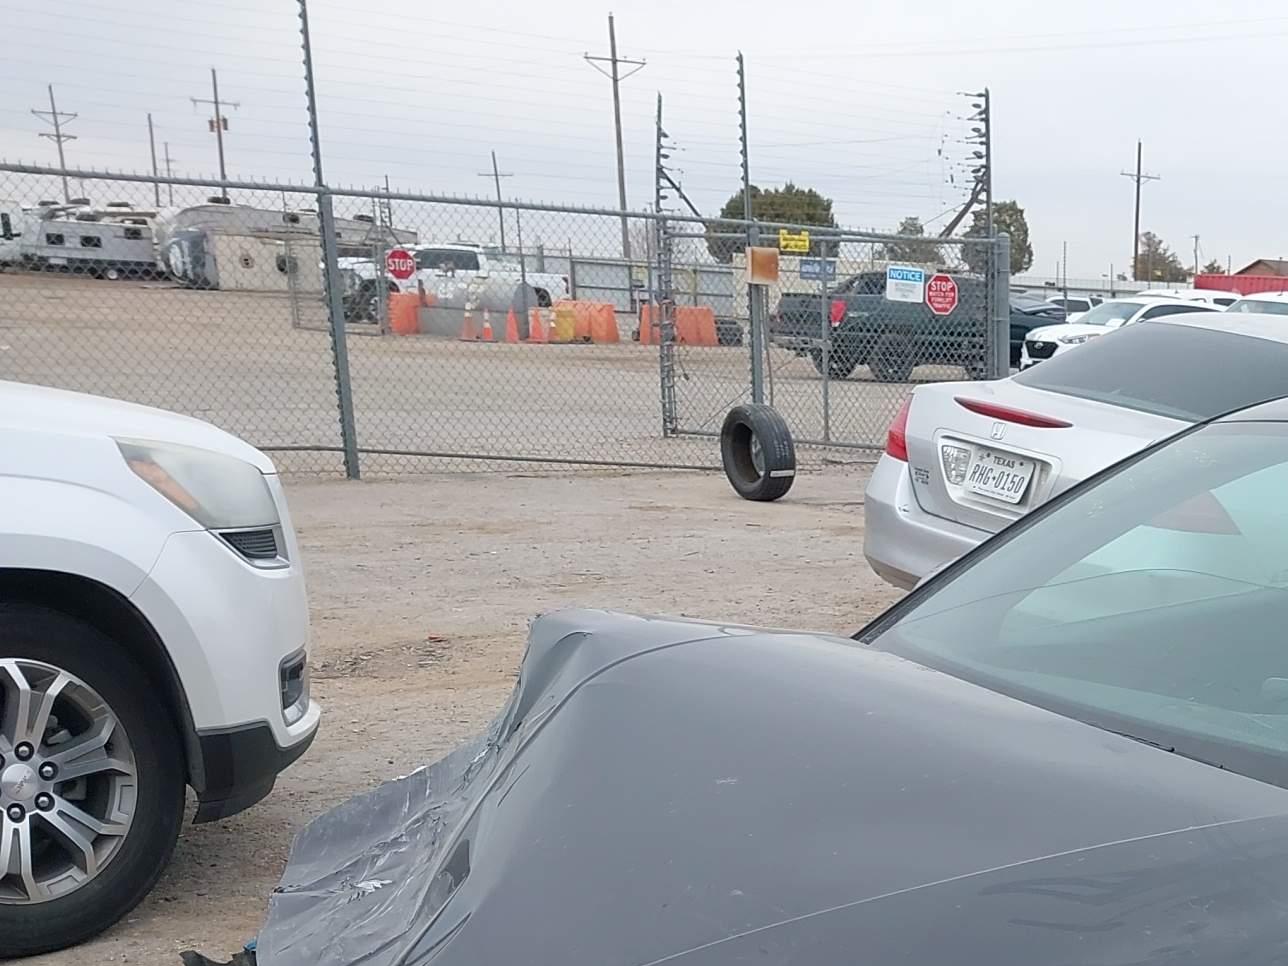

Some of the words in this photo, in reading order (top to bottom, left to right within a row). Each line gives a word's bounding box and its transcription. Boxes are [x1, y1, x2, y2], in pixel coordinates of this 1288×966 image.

[389, 258, 413, 271] STOP
[889, 269, 922, 281] NOTICE
[930, 280, 953, 292] STOP
[993, 455, 1015, 469] TEXAS
